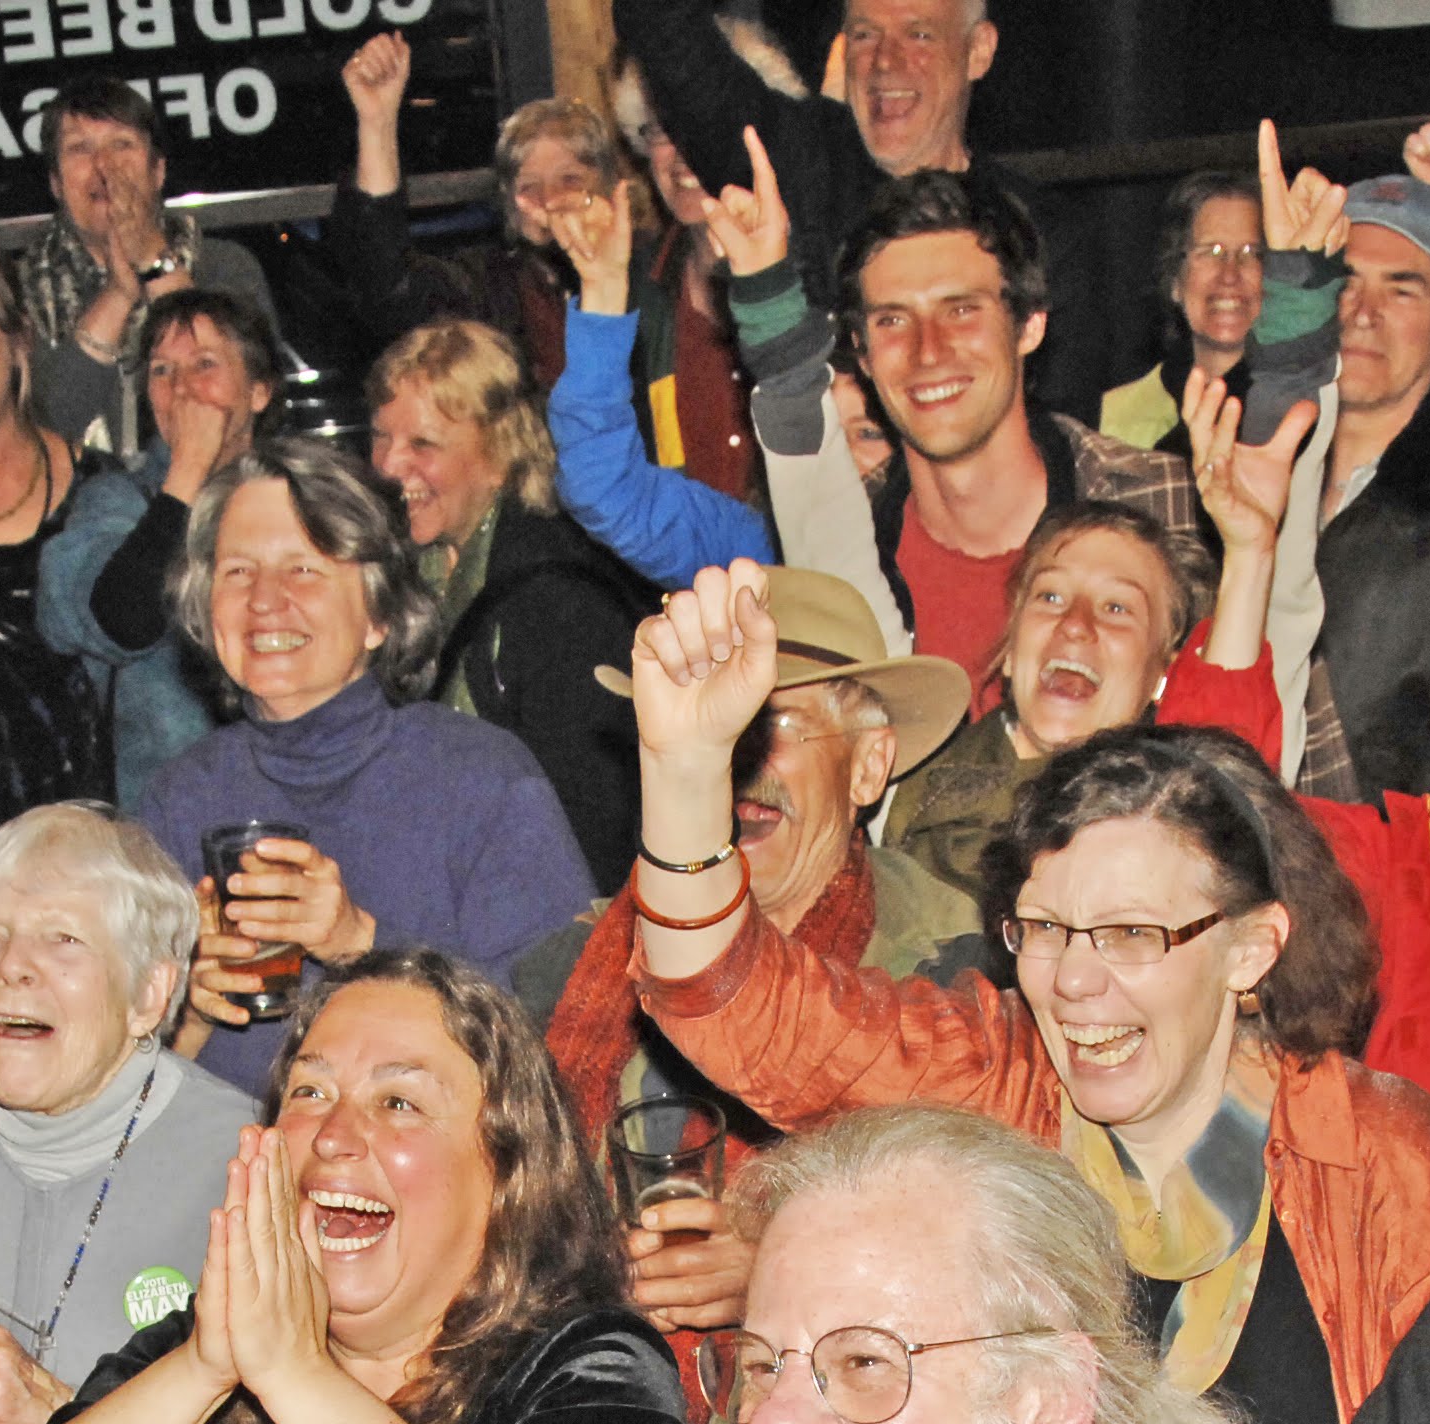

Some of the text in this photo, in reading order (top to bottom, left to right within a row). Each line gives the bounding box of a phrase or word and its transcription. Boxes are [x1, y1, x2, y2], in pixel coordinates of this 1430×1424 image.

[126, 1281, 188, 1302] ELIZABETH
[142, 1276, 168, 1288] VOTE
[128, 1292, 190, 1325] MAY
